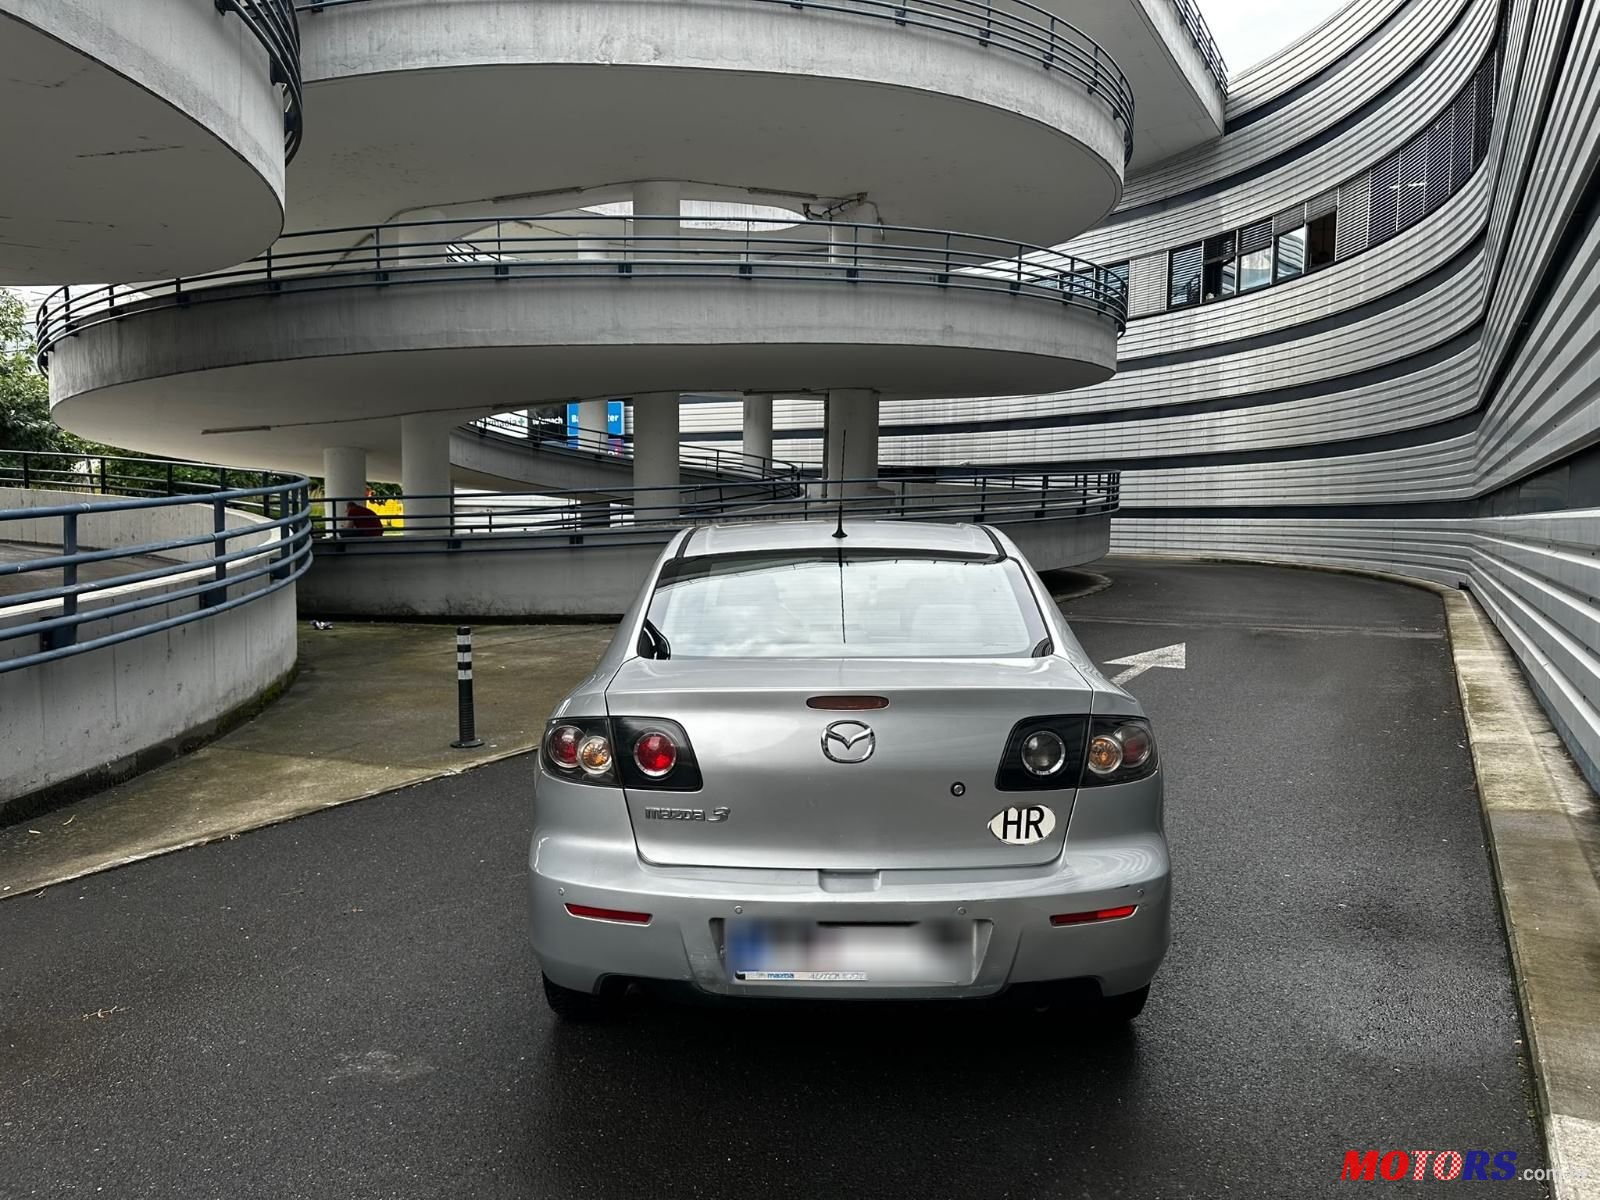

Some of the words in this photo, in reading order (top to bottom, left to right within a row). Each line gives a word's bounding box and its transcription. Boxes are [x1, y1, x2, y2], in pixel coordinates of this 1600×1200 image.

[645, 806, 705, 822] mazda
[707, 806, 731, 823] 3
[1002, 806, 1045, 840] HR
